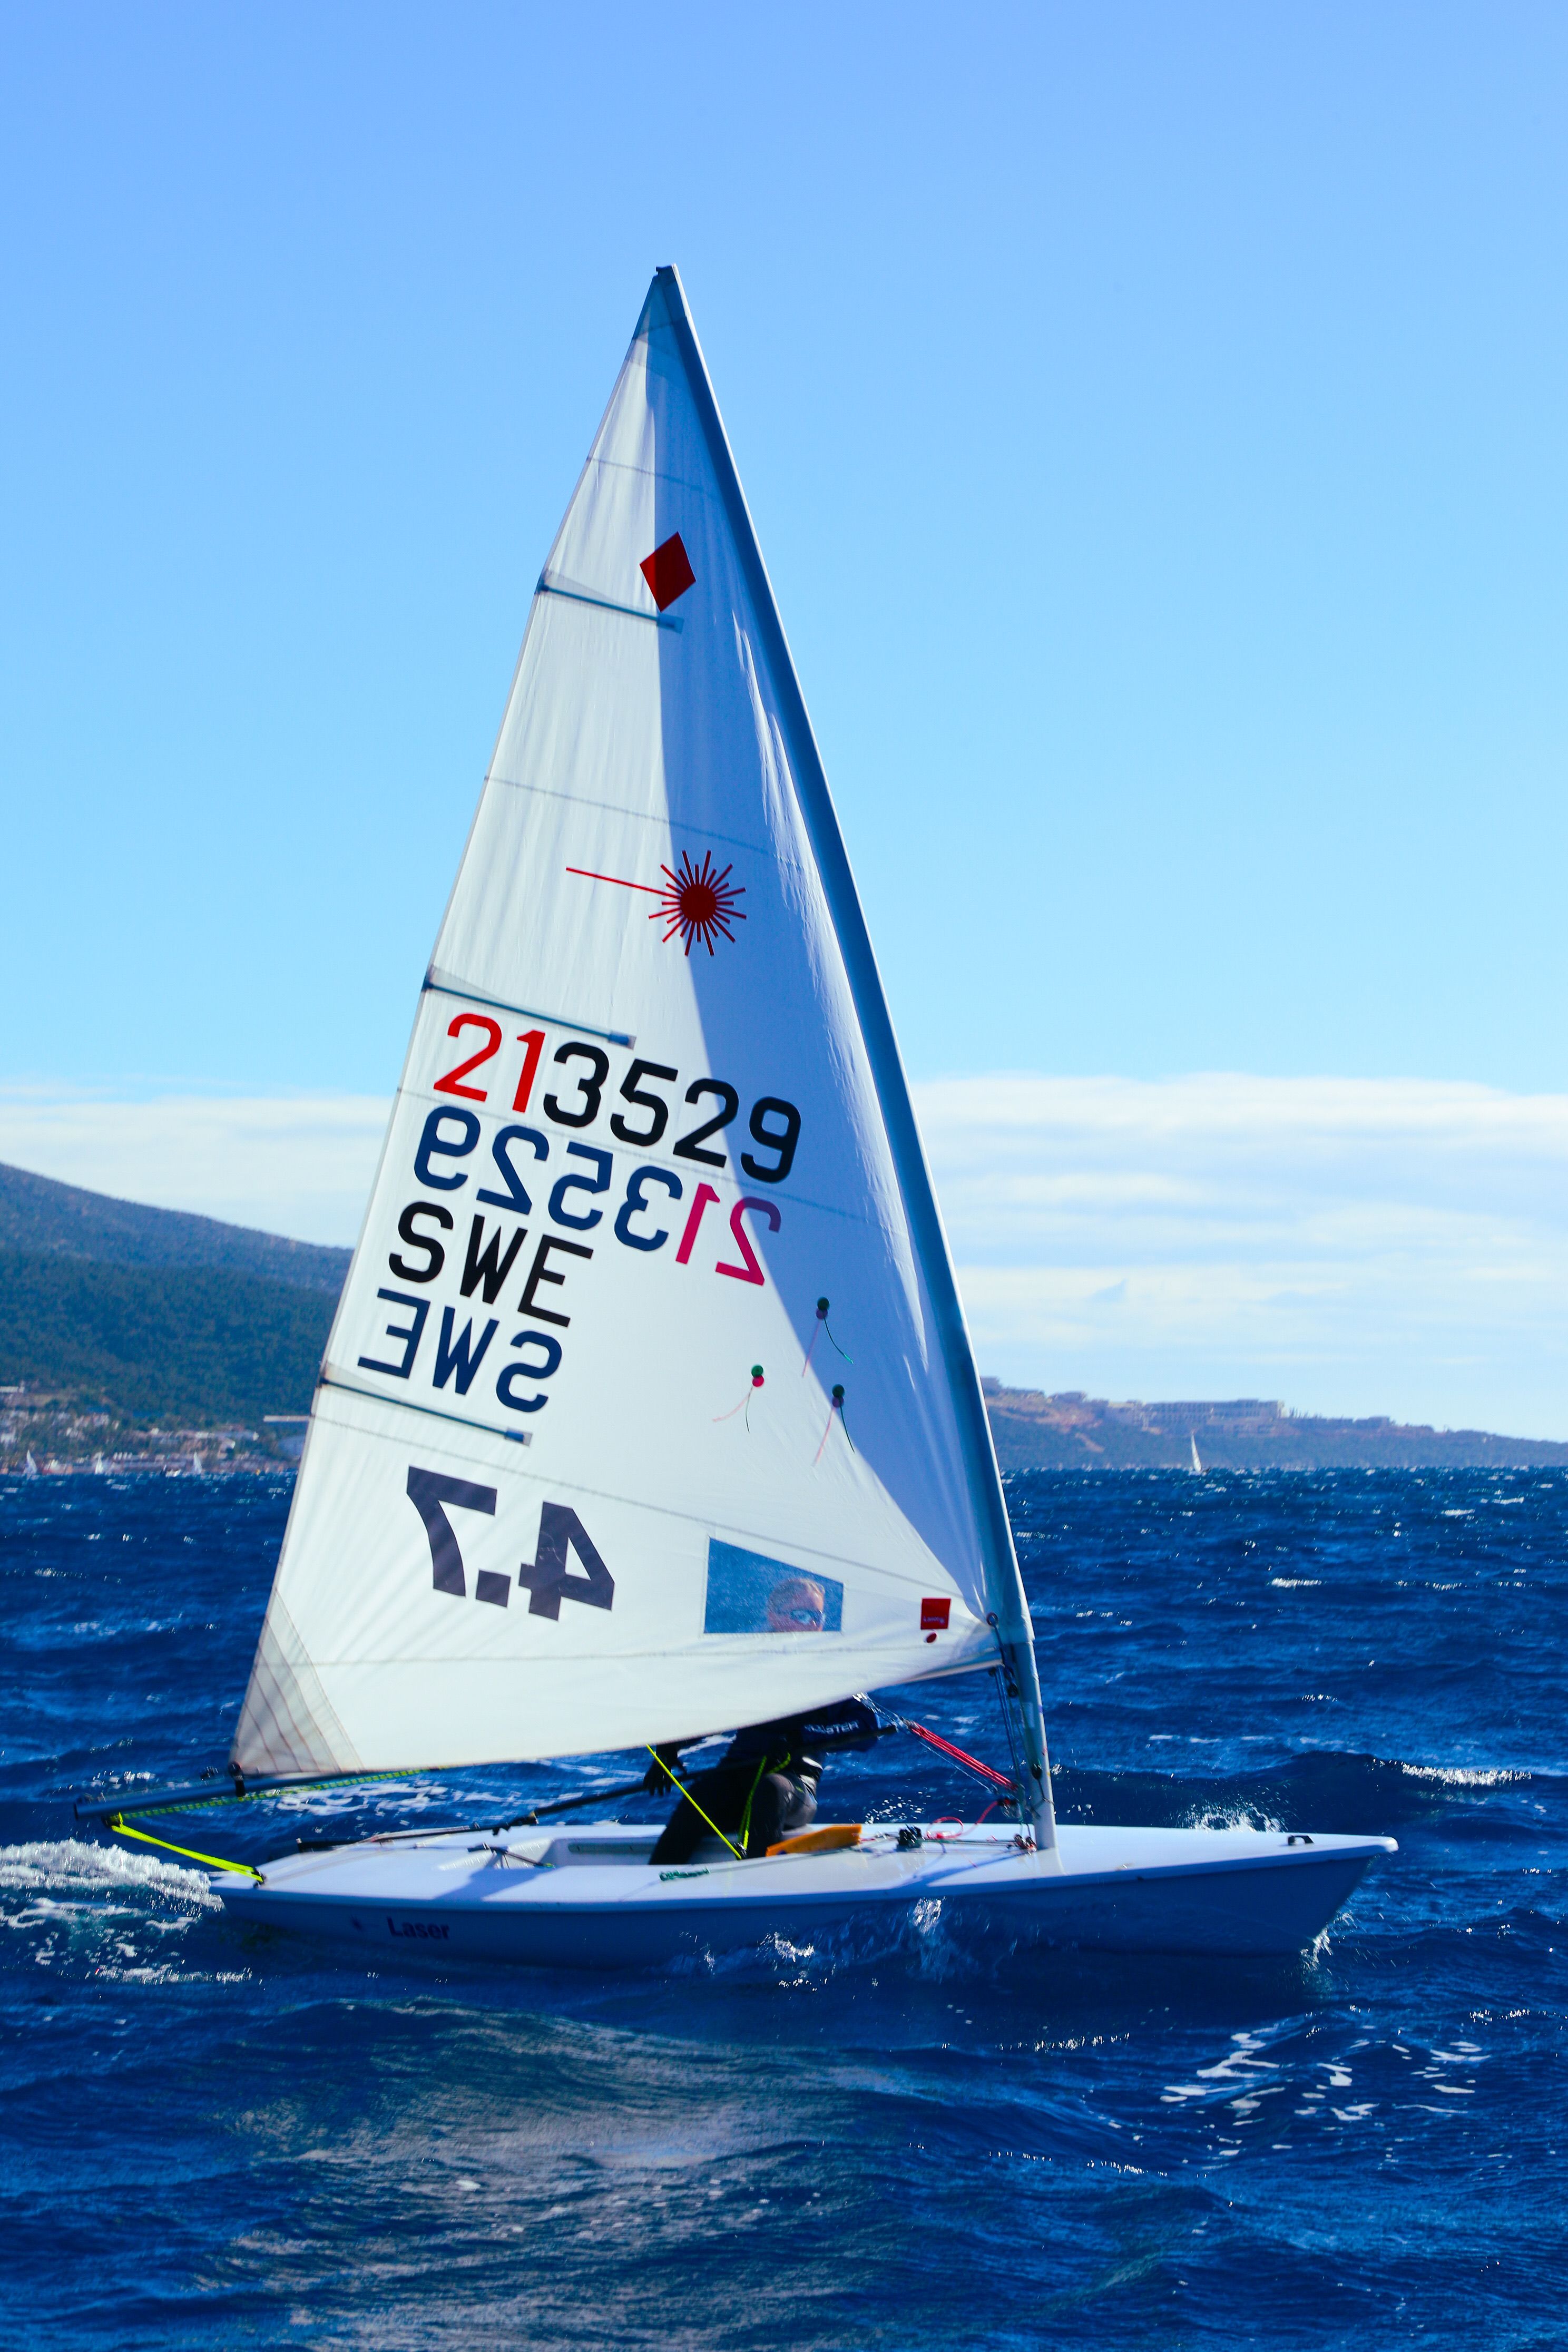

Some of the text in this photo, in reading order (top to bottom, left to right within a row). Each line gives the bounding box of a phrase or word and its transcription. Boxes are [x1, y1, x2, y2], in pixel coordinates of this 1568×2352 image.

[433, 1013, 802, 1183] 213529
[388, 1201, 594, 1328] SWE
[386, 1916, 449, 1939] Laser
